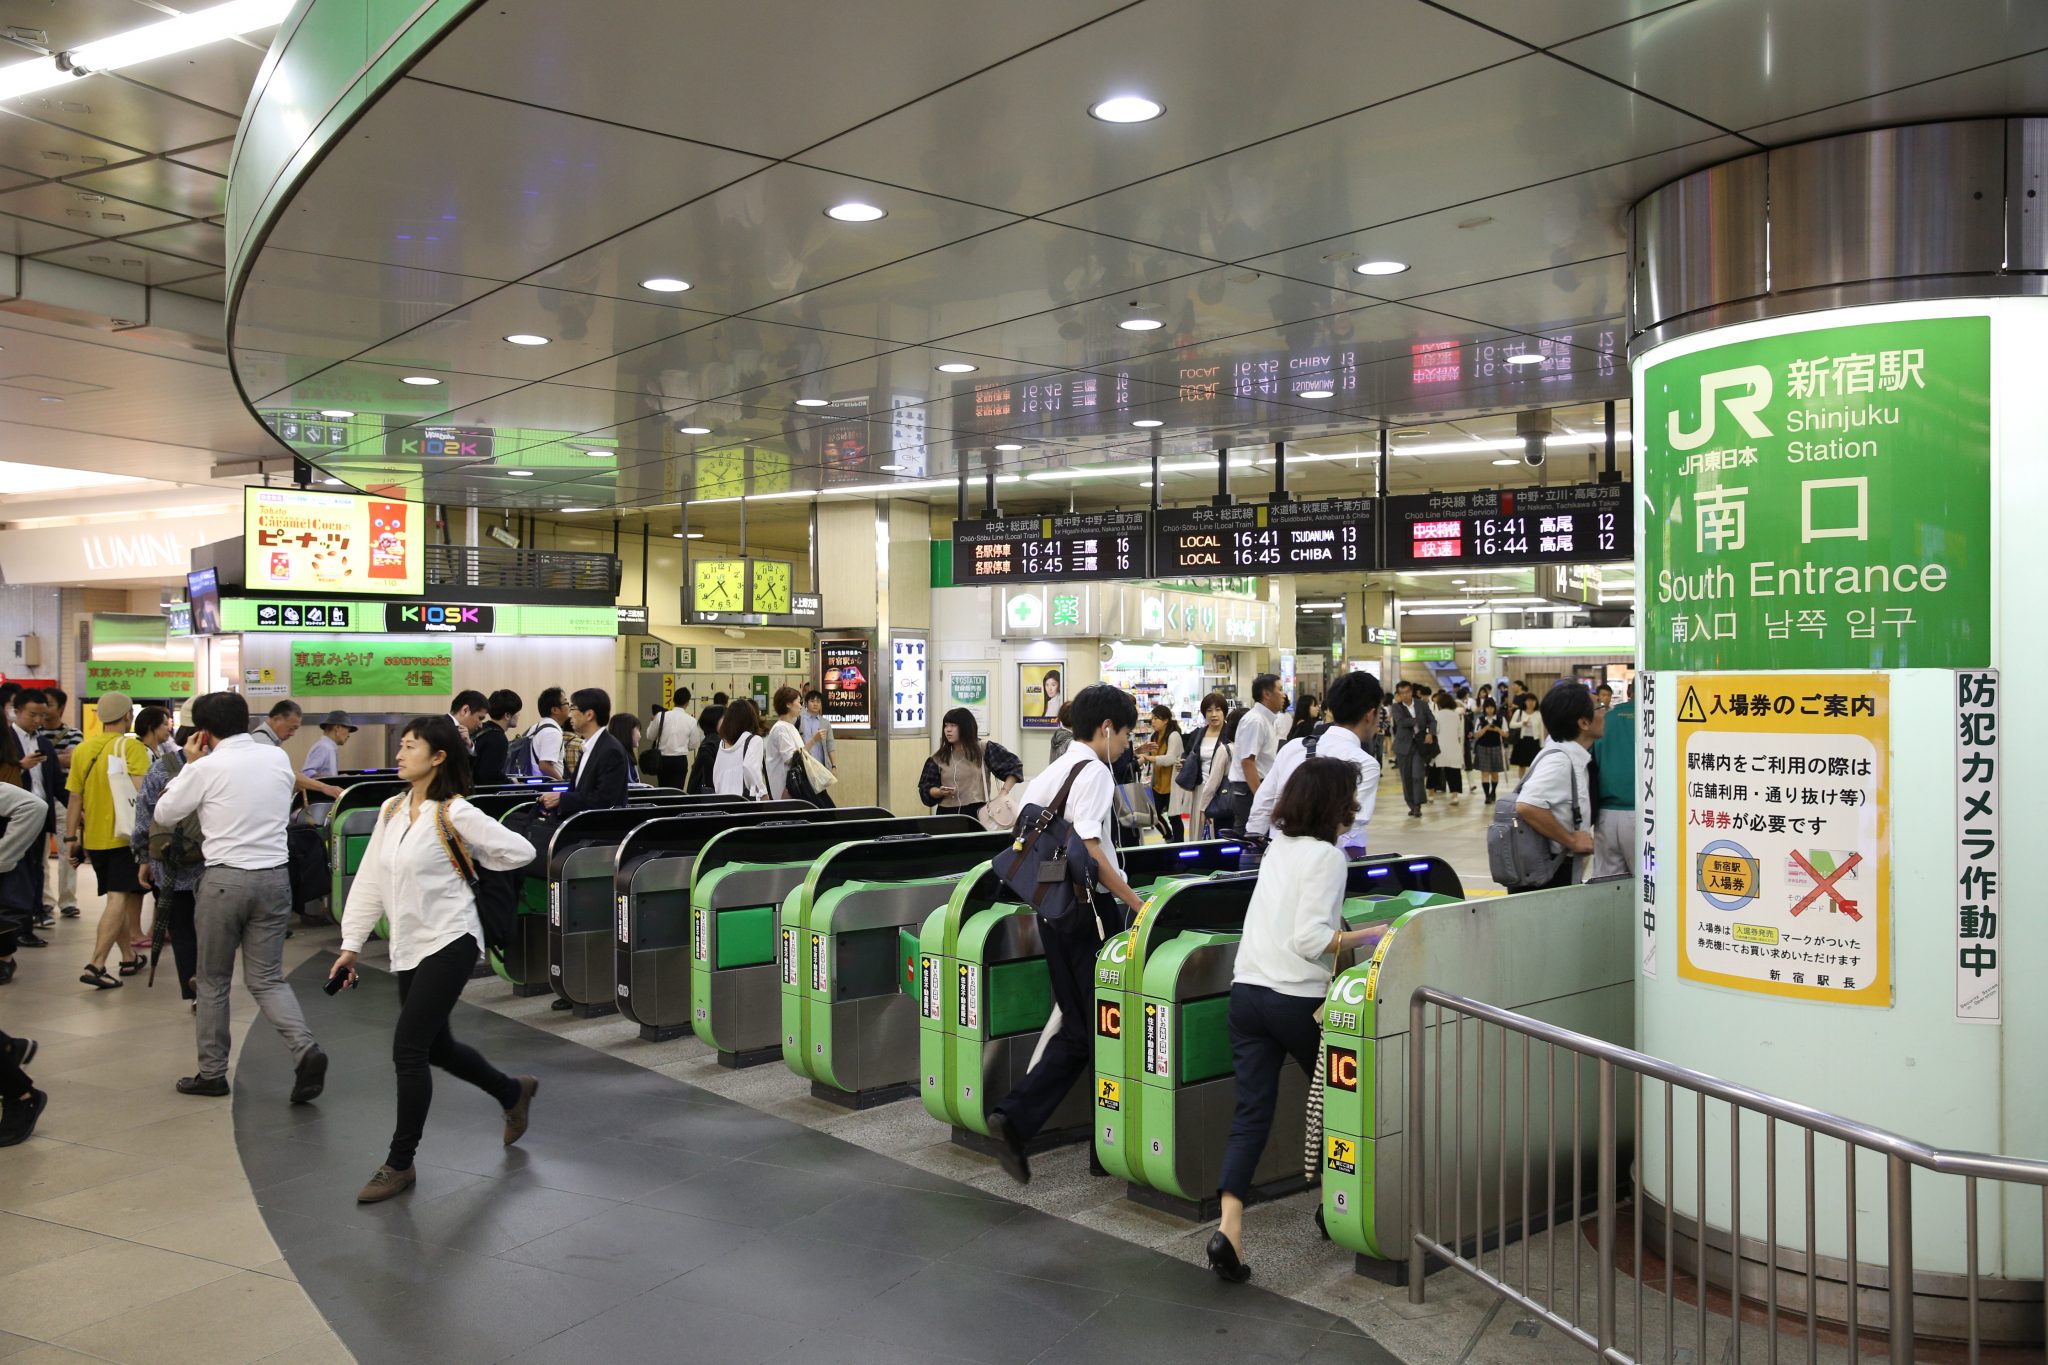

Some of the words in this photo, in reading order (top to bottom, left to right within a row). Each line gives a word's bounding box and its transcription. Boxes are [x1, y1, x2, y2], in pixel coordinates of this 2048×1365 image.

[1786, 349, 1925, 400] 新宿駅
[1668, 364, 1774, 450] JR
[1786, 404, 1899, 433] Shinjuku
[1678, 446, 1758, 476] JR東日本
[1786, 438, 1877, 463] Station
[1430, 496, 1466, 509] 中央線
[1472, 494, 1497, 507] 快速
[1414, 522, 1461, 538] 中央特快
[1474, 518, 1525, 536] 16:41
[1540, 516, 1573, 533] 高尾
[1598, 513, 1614, 531] 12
[259, 529, 349, 550] ピーナッツ
[1022, 540, 1061, 557] 16:41
[1072, 540, 1098, 555] 三鷹
[1117, 538, 1129, 553] 16
[1180, 536, 1220, 548] LOCAL
[1234, 530, 1278, 547] 16:41
[1291, 530, 1334, 543] TSUDANUMA
[1342, 526, 1356, 543] 13
[1474, 537, 1528, 556] 16:44
[1540, 536, 1573, 552] 高尾
[1598, 533, 1614, 550] 12
[975, 544, 1011, 559] 各駅停車
[1180, 553, 1220, 566] LOCAL
[1234, 548, 1280, 565] 16:45
[1291, 548, 1332, 561] CHIBA
[1342, 545, 1356, 561] 13
[1421, 541, 1452, 557] 快速
[975, 560, 1011, 575] 各駅停車
[1022, 558, 1063, 574] 16:45
[1072, 556, 1098, 572] 三鷹
[1117, 555, 1129, 570] 16
[1555, 565, 1567, 593] 14
[1658, 565, 1734, 602] South
[1750, 560, 1947, 597] Entrance
[402, 606, 478, 622] KIOSK
[1053, 594, 1079, 626] 薬
[1167, 603, 1214, 632] くすり
[1671, 612, 1737, 643] 南入口
[1764, 609, 1828, 640] 남쪽
[1846, 607, 1917, 638] 입구
[295, 652, 373, 666] 東京みやげ
[384, 655, 451, 666] souvenir
[1440, 649, 1451, 660] 15
[305, 670, 352, 685] 纪念品
[405, 671, 435, 687] 선물
[828, 691, 862, 700] 約2時間の
[1710, 694, 1875, 718] 入場券のご案内
[1688, 752, 1871, 776] 駅構内をご利用の際は
[1643, 674, 1655, 937] 防犯カメラ作動中
[1688, 809, 1827, 835] 入場券が必要です
[1959, 673, 1996, 978] 防犯カメラ作動中
[1713, 860, 1740, 873] 新宿駅
[1709, 875, 1744, 891] 入場券
[1698, 921, 1730, 936] 入場券は
[1781, 933, 1860, 949] マークがついた
[1101, 938, 1127, 963] IC
[1698, 937, 1860, 966] 券売機にてお買い求めいただけます
[1099, 968, 1119, 985] 専用
[1332, 975, 1366, 1004] IC
[1102, 1007, 1121, 1035] IC
[1328, 1010, 1355, 1030] 専用
[1333, 1053, 1356, 1087] IC
[1106, 1127, 1111, 1137] 7
[1153, 1141, 1159, 1152] 6
[1338, 1194, 1344, 1205] 6
